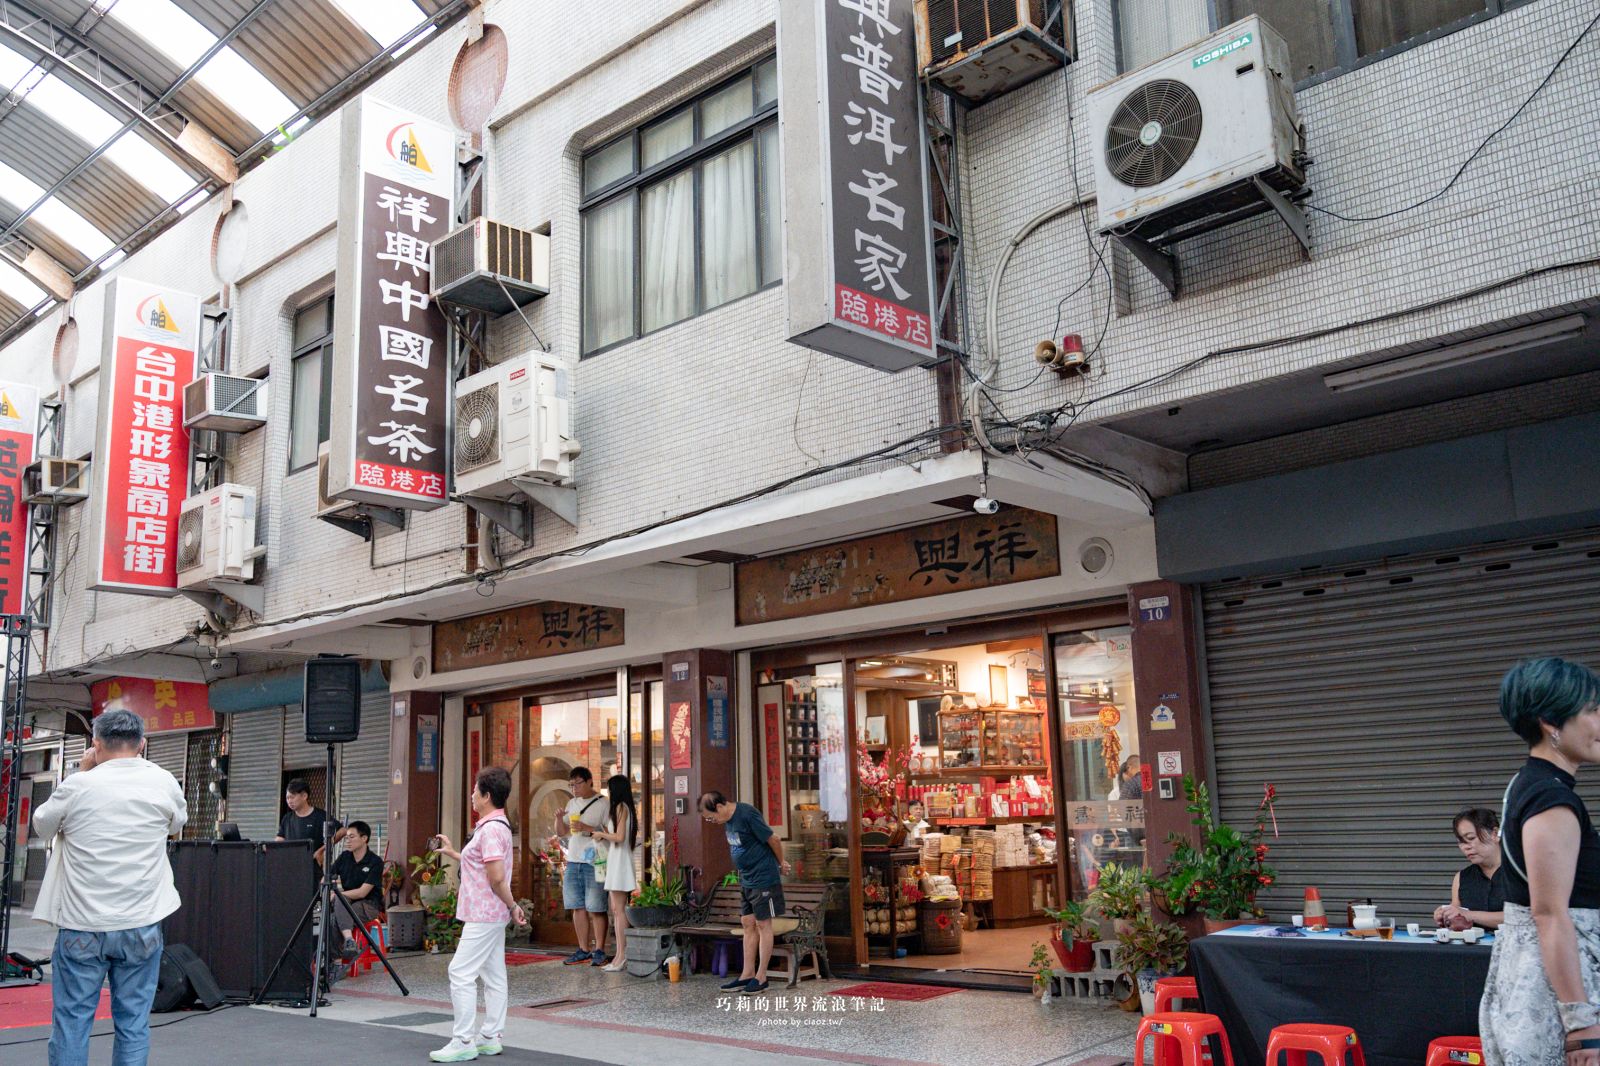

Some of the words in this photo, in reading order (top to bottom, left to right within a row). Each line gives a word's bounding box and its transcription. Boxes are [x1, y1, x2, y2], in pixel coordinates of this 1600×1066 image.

[1194, 37, 1250, 65] TOSHIBA
[367, 185, 437, 463] 祥興中國名茶
[839, 290, 930, 346] 臨港店
[123, 346, 176, 574] 台中港形象商店街
[359, 463, 445, 497] 臨港店
[1148, 608, 1163, 620] 10
